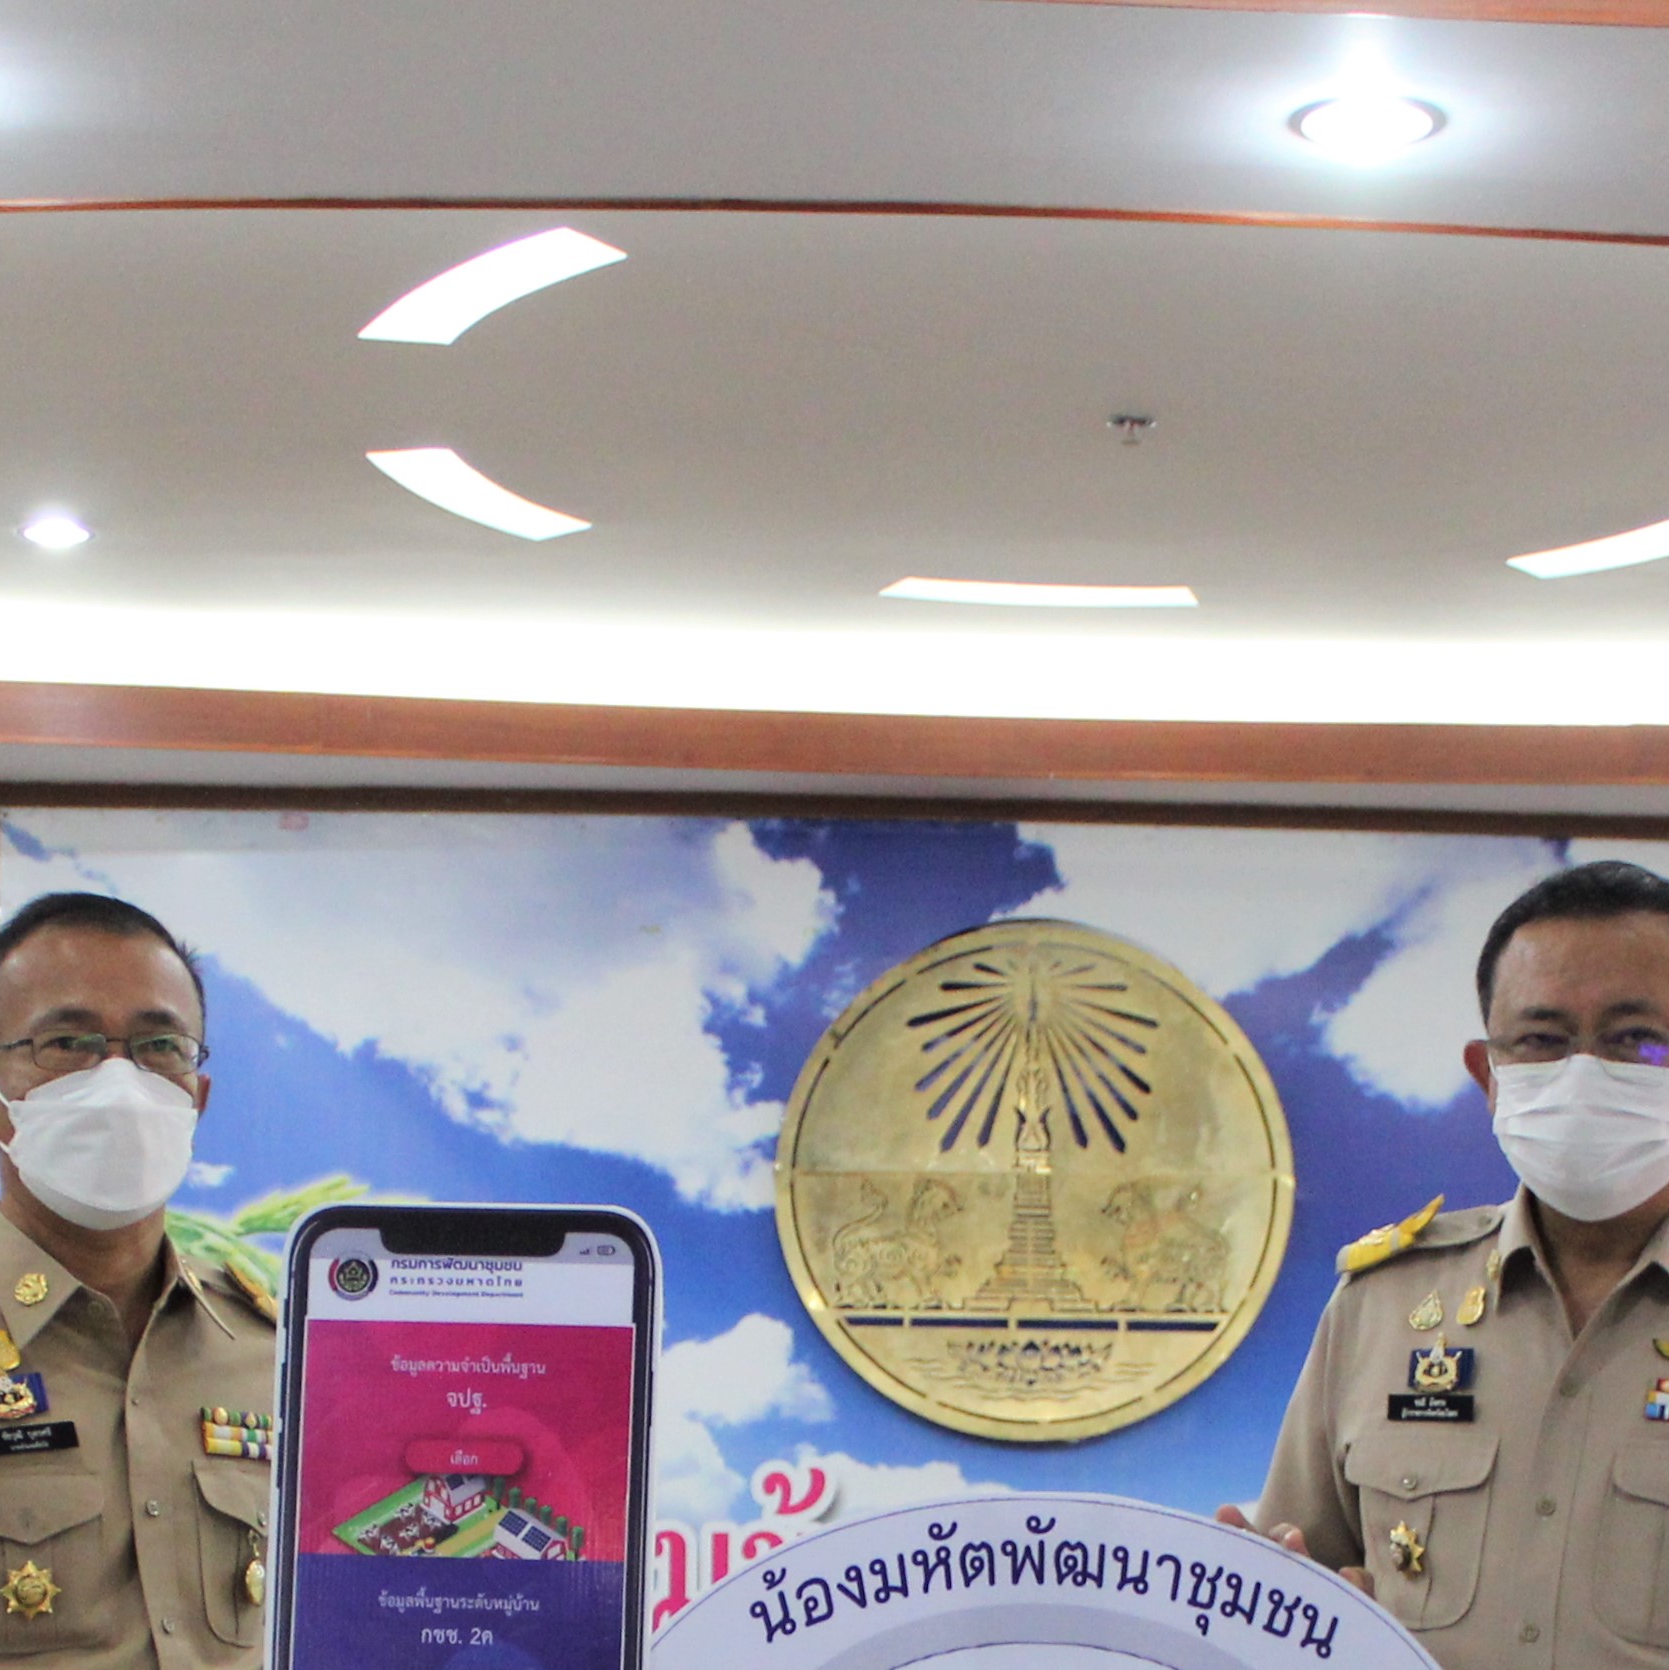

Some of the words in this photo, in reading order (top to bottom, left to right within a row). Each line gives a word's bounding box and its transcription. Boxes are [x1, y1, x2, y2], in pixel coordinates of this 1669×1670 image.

[391, 1257, 523, 1274] กรมการพัฒนาชุมชน
[390, 1353, 547, 1379] ข้อมูลความจำเป็นพื้นฐาน
[446, 1387, 487, 1414] จปฐ.
[750, 1515, 1341, 1658] น้องมหัตพัฒนาชุมชน
[377, 1586, 540, 1617] ข้อมูลพื้นฐานระดับหมู่บ้าน
